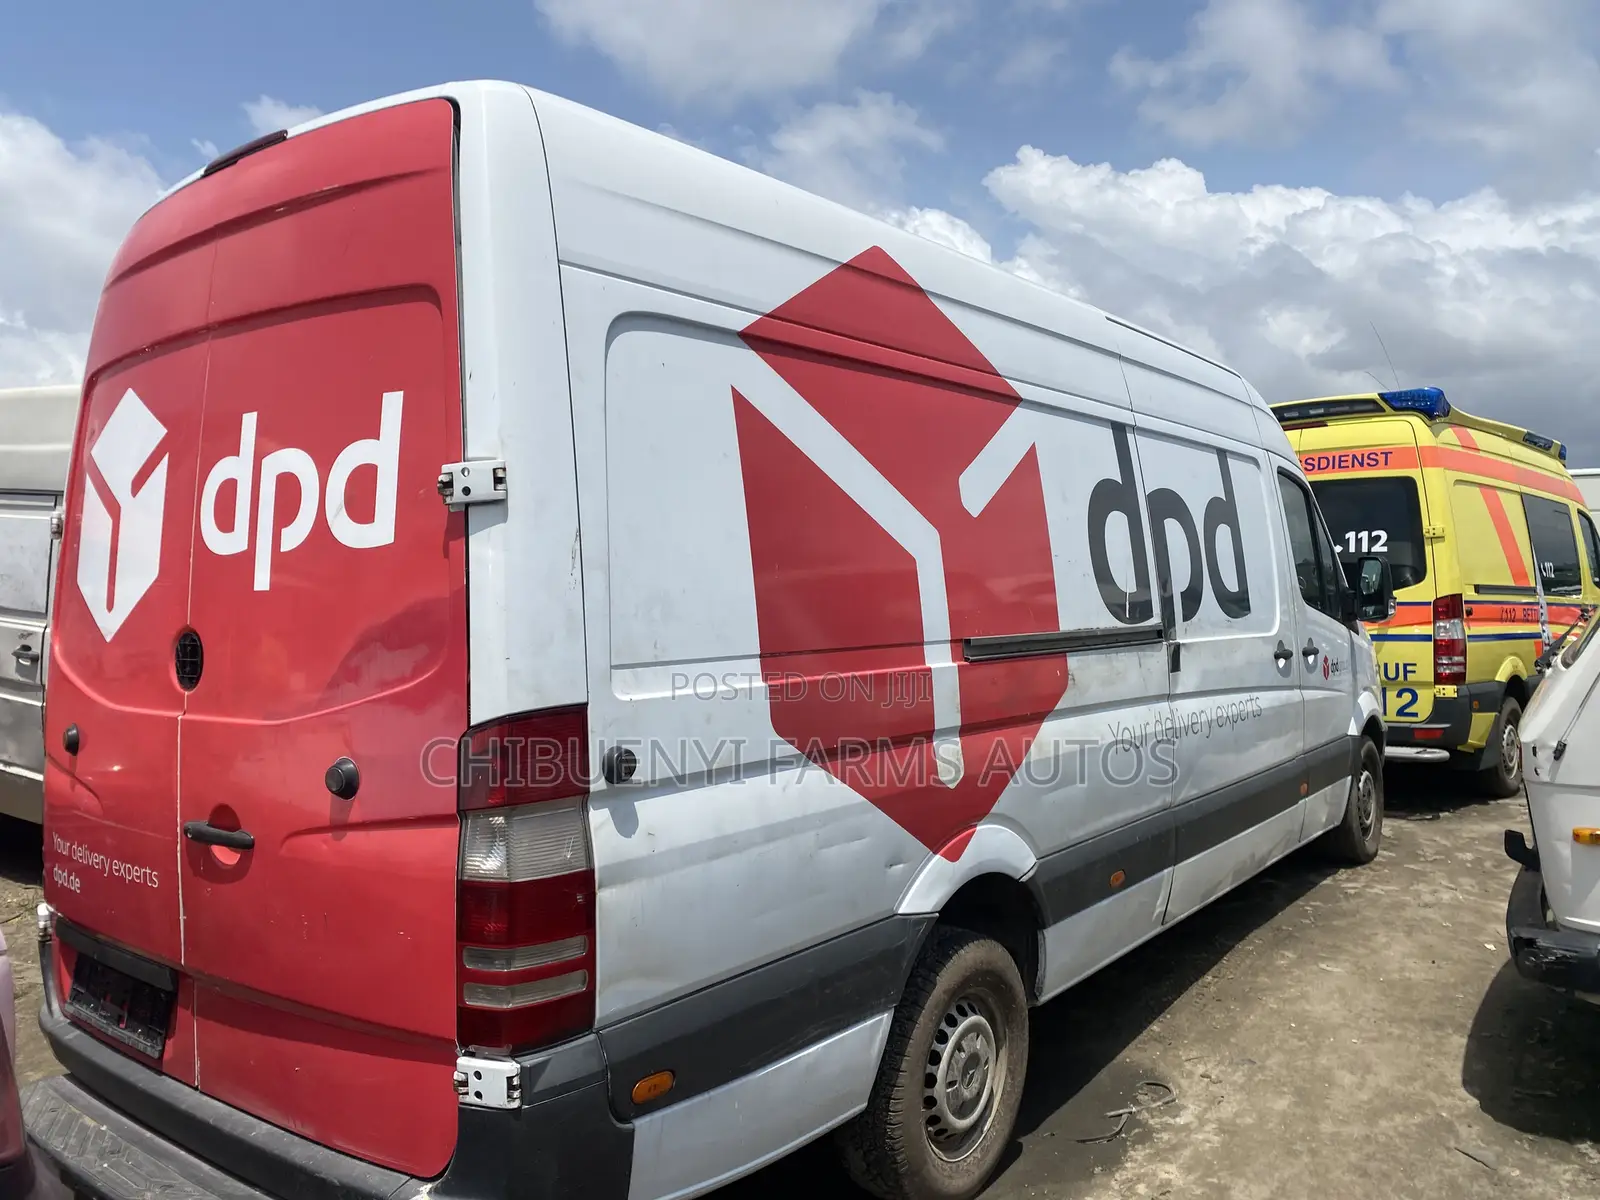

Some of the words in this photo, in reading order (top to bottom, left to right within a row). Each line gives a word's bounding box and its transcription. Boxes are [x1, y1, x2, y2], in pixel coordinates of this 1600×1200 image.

[1299, 451, 1393, 472] SDIENST
[200, 390, 404, 592] dpd
[1087, 420, 1251, 673] dpd
[1345, 530, 1388, 553] 112
[1108, 721, 1150, 755] Your
[1154, 705, 1213, 743] delivery
[1216, 694, 1263, 731] experts
[53, 831, 71, 857] Your
[71, 841, 110, 877] delivery
[112, 859, 159, 888] experts
[53, 863, 81, 894] dpd.de
